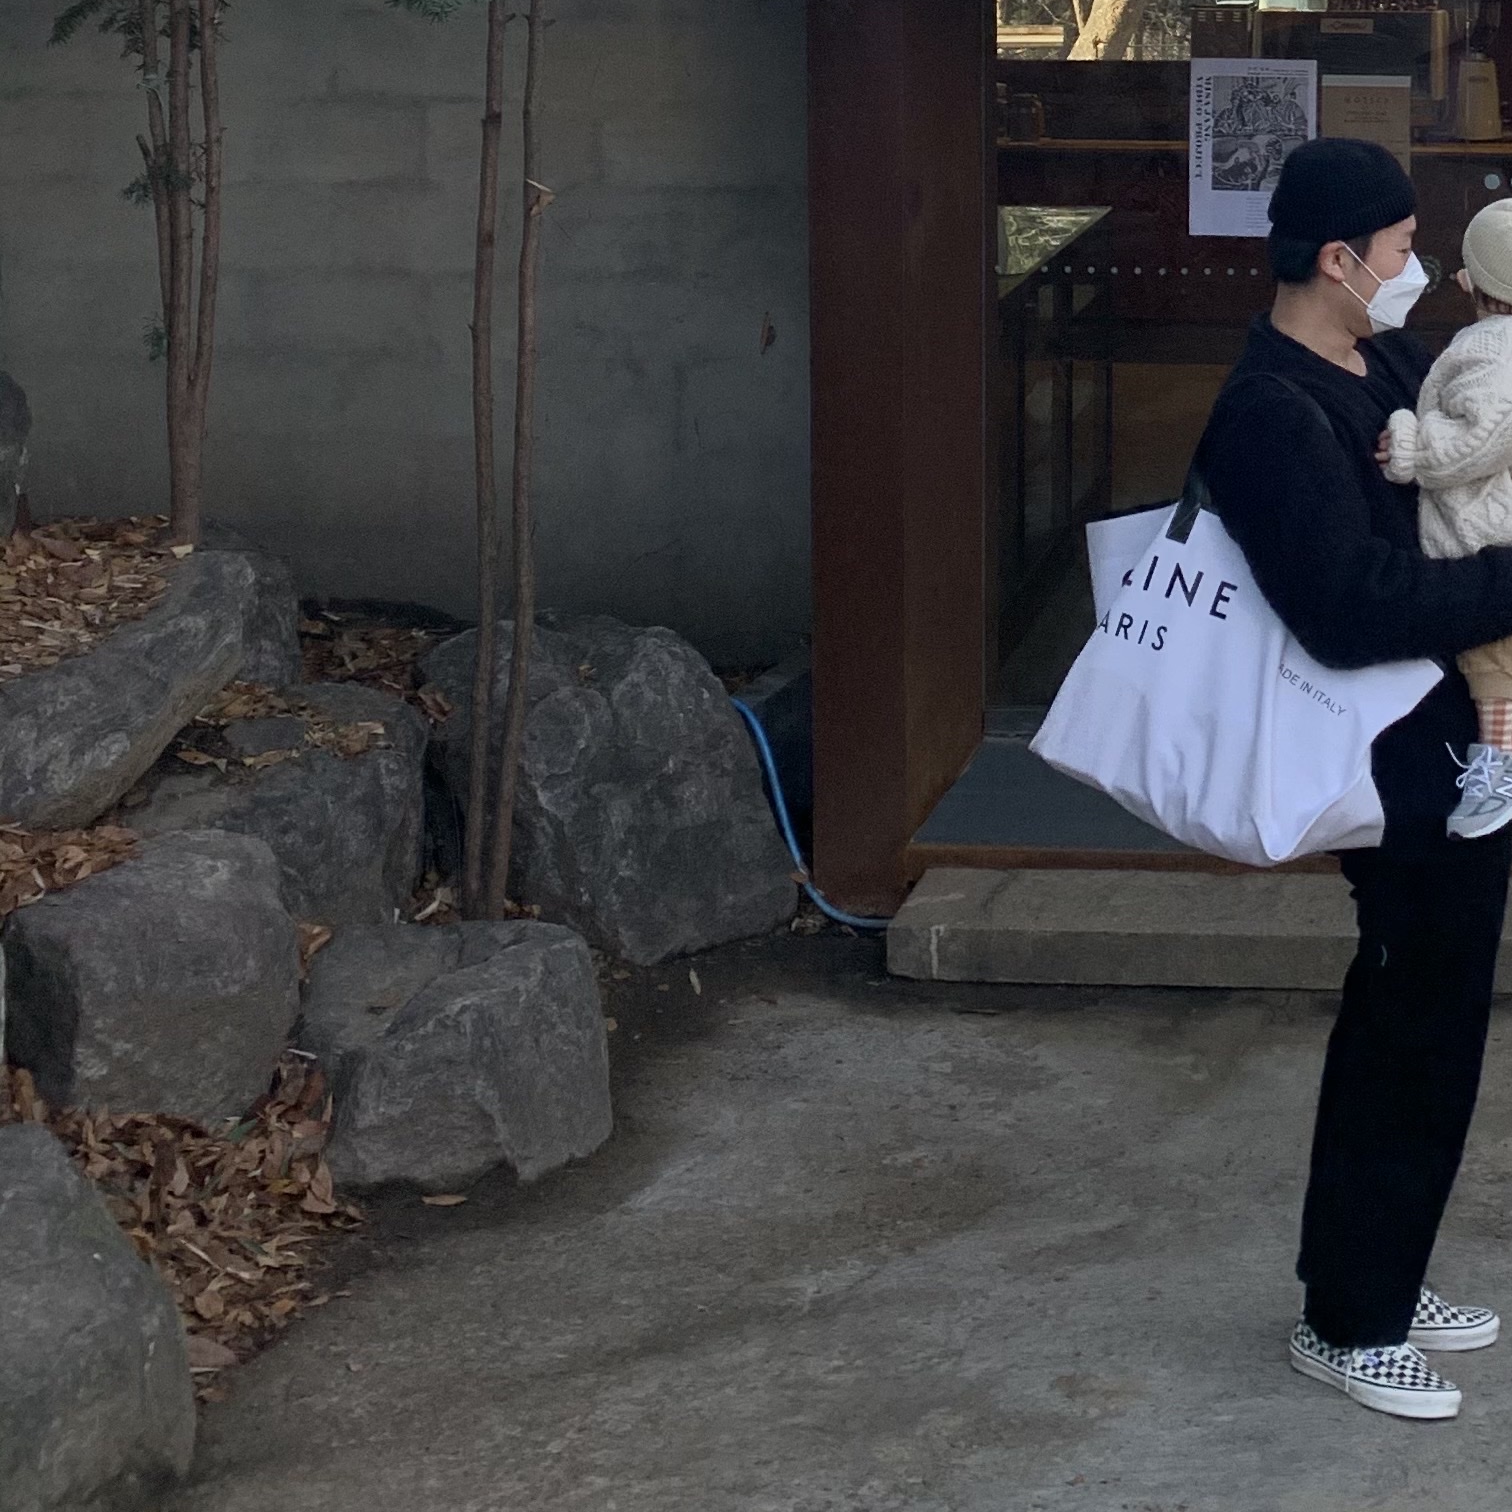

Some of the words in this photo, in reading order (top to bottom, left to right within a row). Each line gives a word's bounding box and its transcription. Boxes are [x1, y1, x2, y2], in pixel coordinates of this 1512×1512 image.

[1194, 121, 1203, 180] PROJECT
[1299, 680, 1314, 695] IN
[1312, 690, 1347, 716] ITALY
